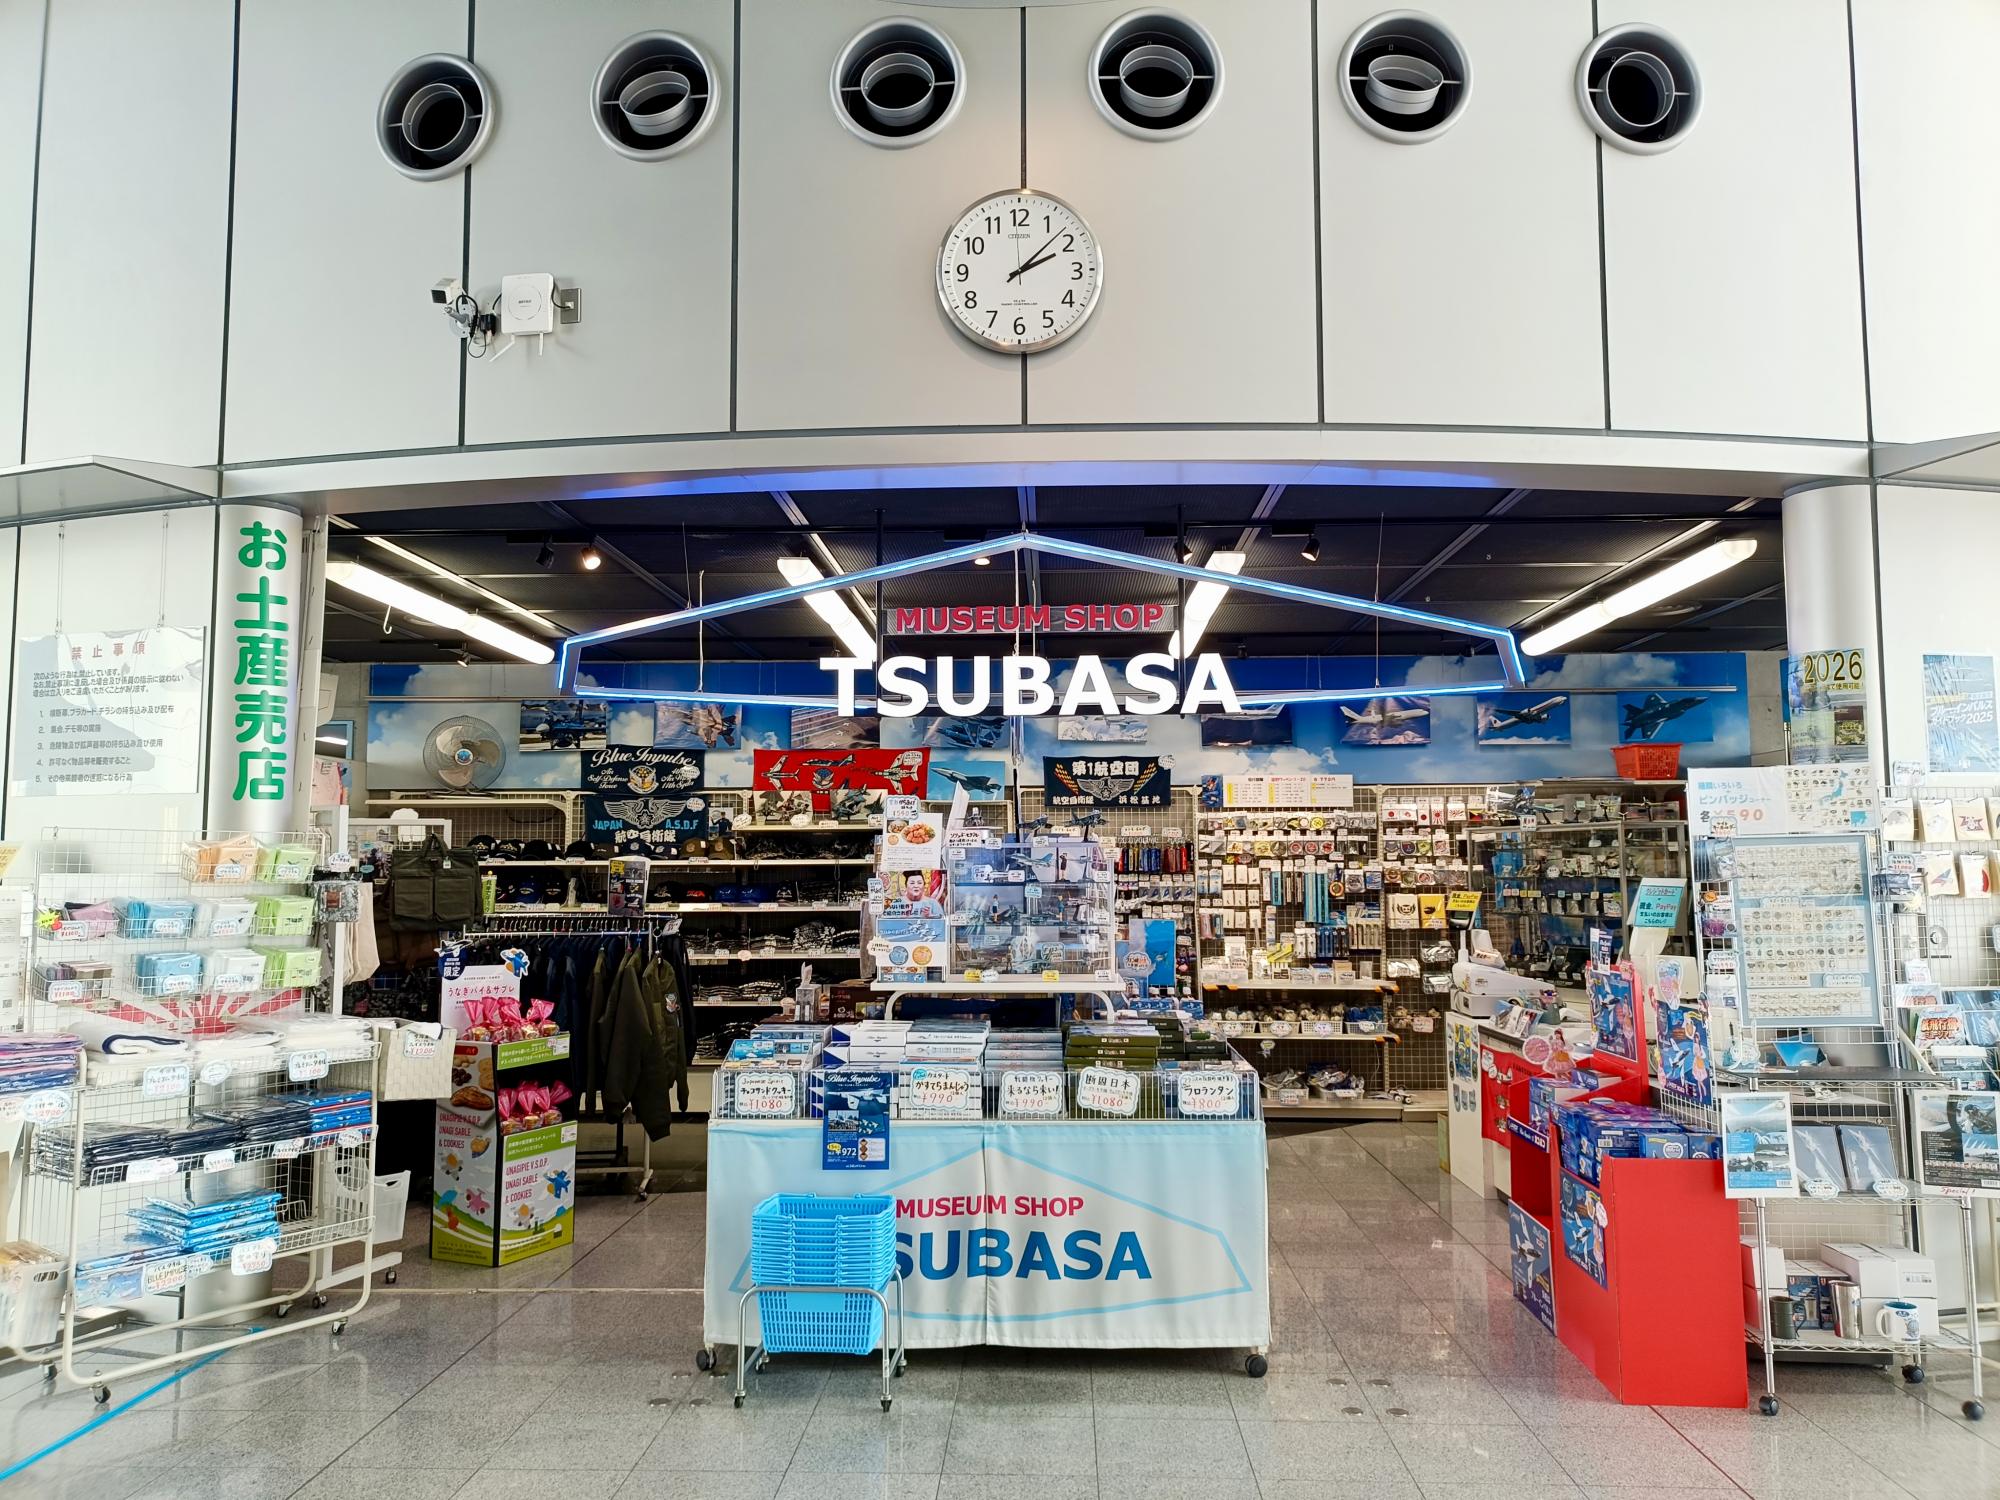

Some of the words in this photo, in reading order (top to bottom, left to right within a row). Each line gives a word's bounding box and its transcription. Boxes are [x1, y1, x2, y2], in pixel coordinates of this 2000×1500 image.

[984, 216, 1001, 234] 11
[1009, 208, 1030, 227] 12
[1043, 215, 1050, 233] 1
[963, 236, 985, 255] 10
[1062, 234, 1075, 252] 2
[956, 264, 969, 282] 9
[1071, 262, 1083, 280] 3
[964, 291, 977, 309] 8
[1061, 289, 1075, 308] 4
[985, 310, 998, 328] 7
[1013, 317, 1026, 335] 6
[1042, 310, 1054, 328] 5
[895, 605, 1051, 634] MUSEUM
[1064, 603, 1164, 631] SHOP
[71, 641, 145, 660] 禁止事項
[232, 520, 289, 801] お土産売店
[1804, 652, 1862, 683] 2026
[819, 653, 1242, 717] TSUBASA
[1930, 701, 1992, 716] ブルーインパルス
[590, 748, 632, 768] Blue
[632, 748, 696, 766] Impulse
[1072, 760, 1139, 776] 第1航空団
[1052, 796, 1094, 805] 航空自衛隊
[1119, 796, 1160, 805] 浜松基地
[592, 820, 623, 830] JAPAN
[1700, 811, 1710, 822] 各
[1656, 903, 1677, 911] PayPay
[444, 966, 460, 977] 限定
[448, 985, 515, 997] うなぎパイ&サブレ
[825, 1074, 847, 1083] Blue
[848, 1074, 881, 1083] Impulse
[915, 1081, 969, 1092] かすてらまんじゅう
[1184, 1086, 1234, 1096] フロランタン
[439, 1125, 454, 1135] UNAGI
[455, 1127, 471, 1136] SABLE
[443, 1140, 464, 1149] COOKIES
[835, 1148, 856, 1156] ¥972
[506, 1161, 530, 1176] UNAGIPIE
[506, 1178, 521, 1190] UNAGI
[522, 1174, 538, 1186] SABLE
[510, 1189, 532, 1202] COOKIES
[896, 1196, 1007, 1219] MUSEUM
[1015, 1196, 1084, 1216] SHOP
[893, 1229, 1152, 1281] SUBASA
